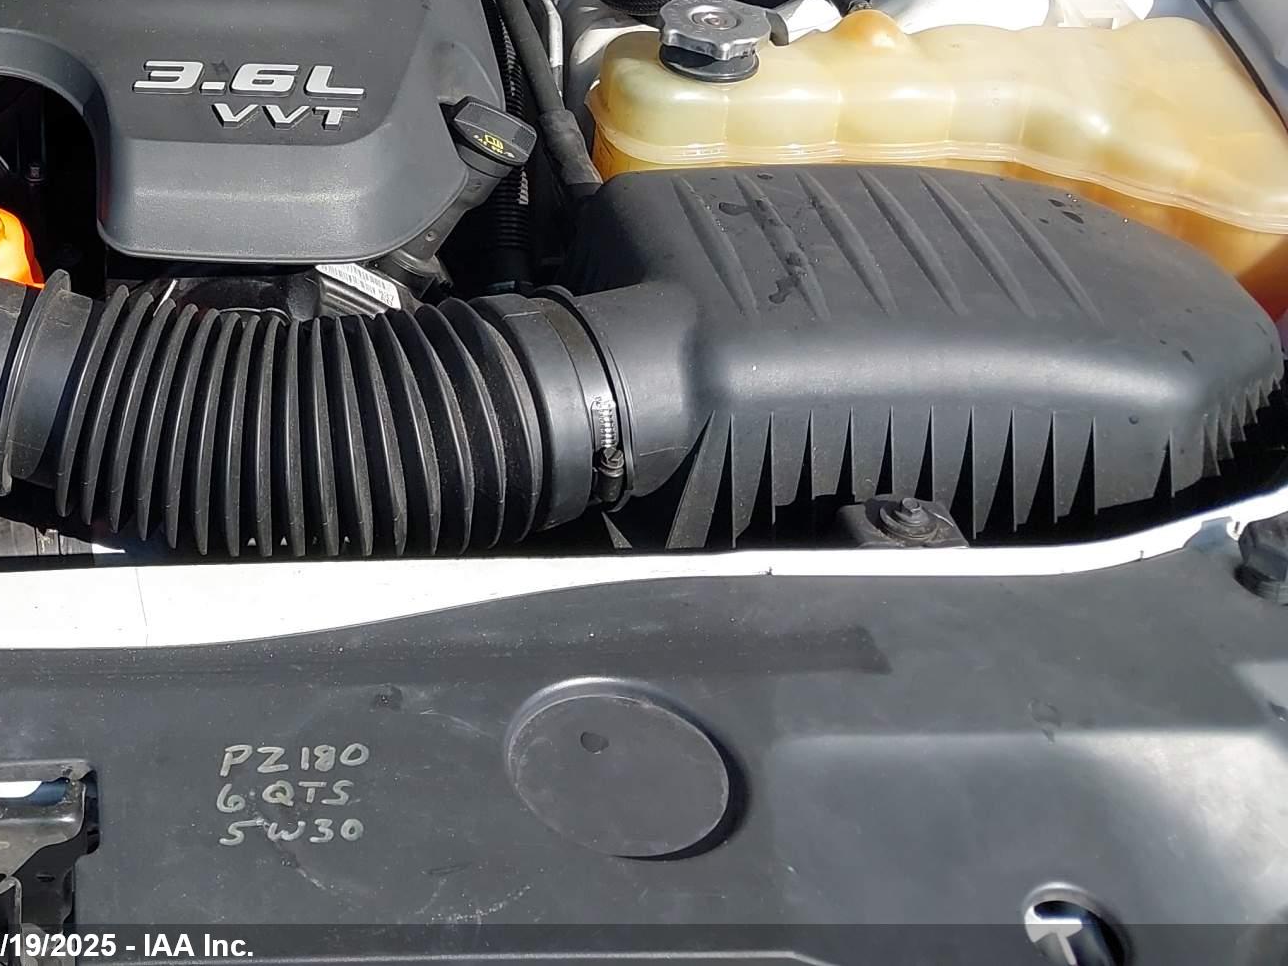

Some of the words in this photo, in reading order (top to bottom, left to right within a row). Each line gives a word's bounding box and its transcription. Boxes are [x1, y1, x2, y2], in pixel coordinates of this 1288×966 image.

[132, 60, 366, 99] 3.6L
[212, 102, 360, 130] VVT
[216, 783, 246, 813] 6
[262, 779, 356, 807] QTS
